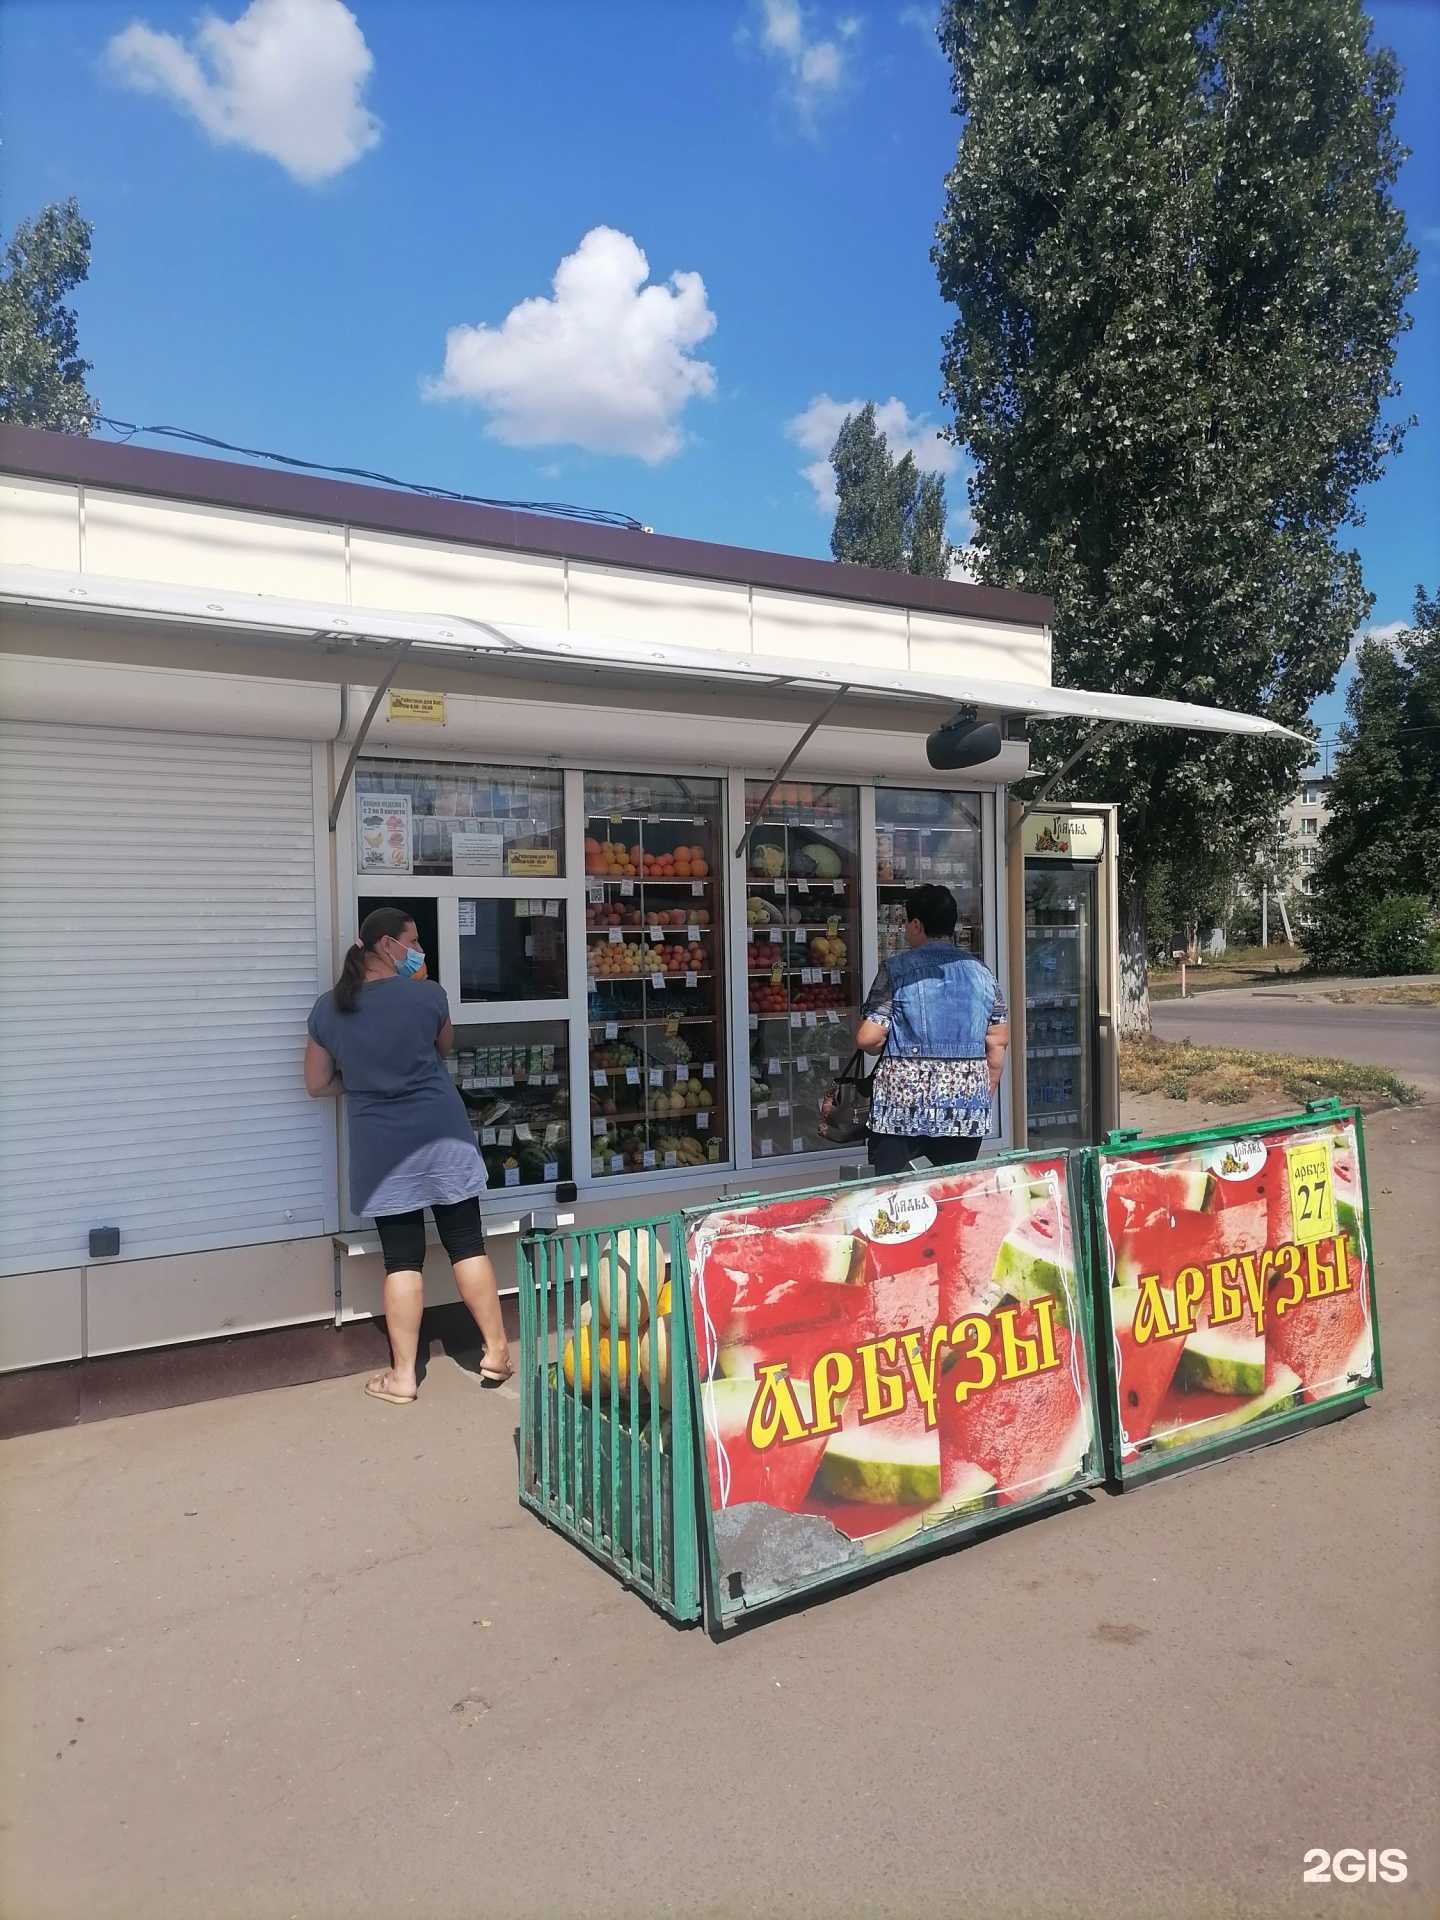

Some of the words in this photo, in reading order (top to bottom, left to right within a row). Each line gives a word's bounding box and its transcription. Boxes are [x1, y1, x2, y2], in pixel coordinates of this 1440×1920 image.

[1297, 1181, 1327, 1221] 27
[1134, 1235, 1352, 1344] АРБУЗЫ
[748, 1298, 1060, 1449] АРБУЗЫ
